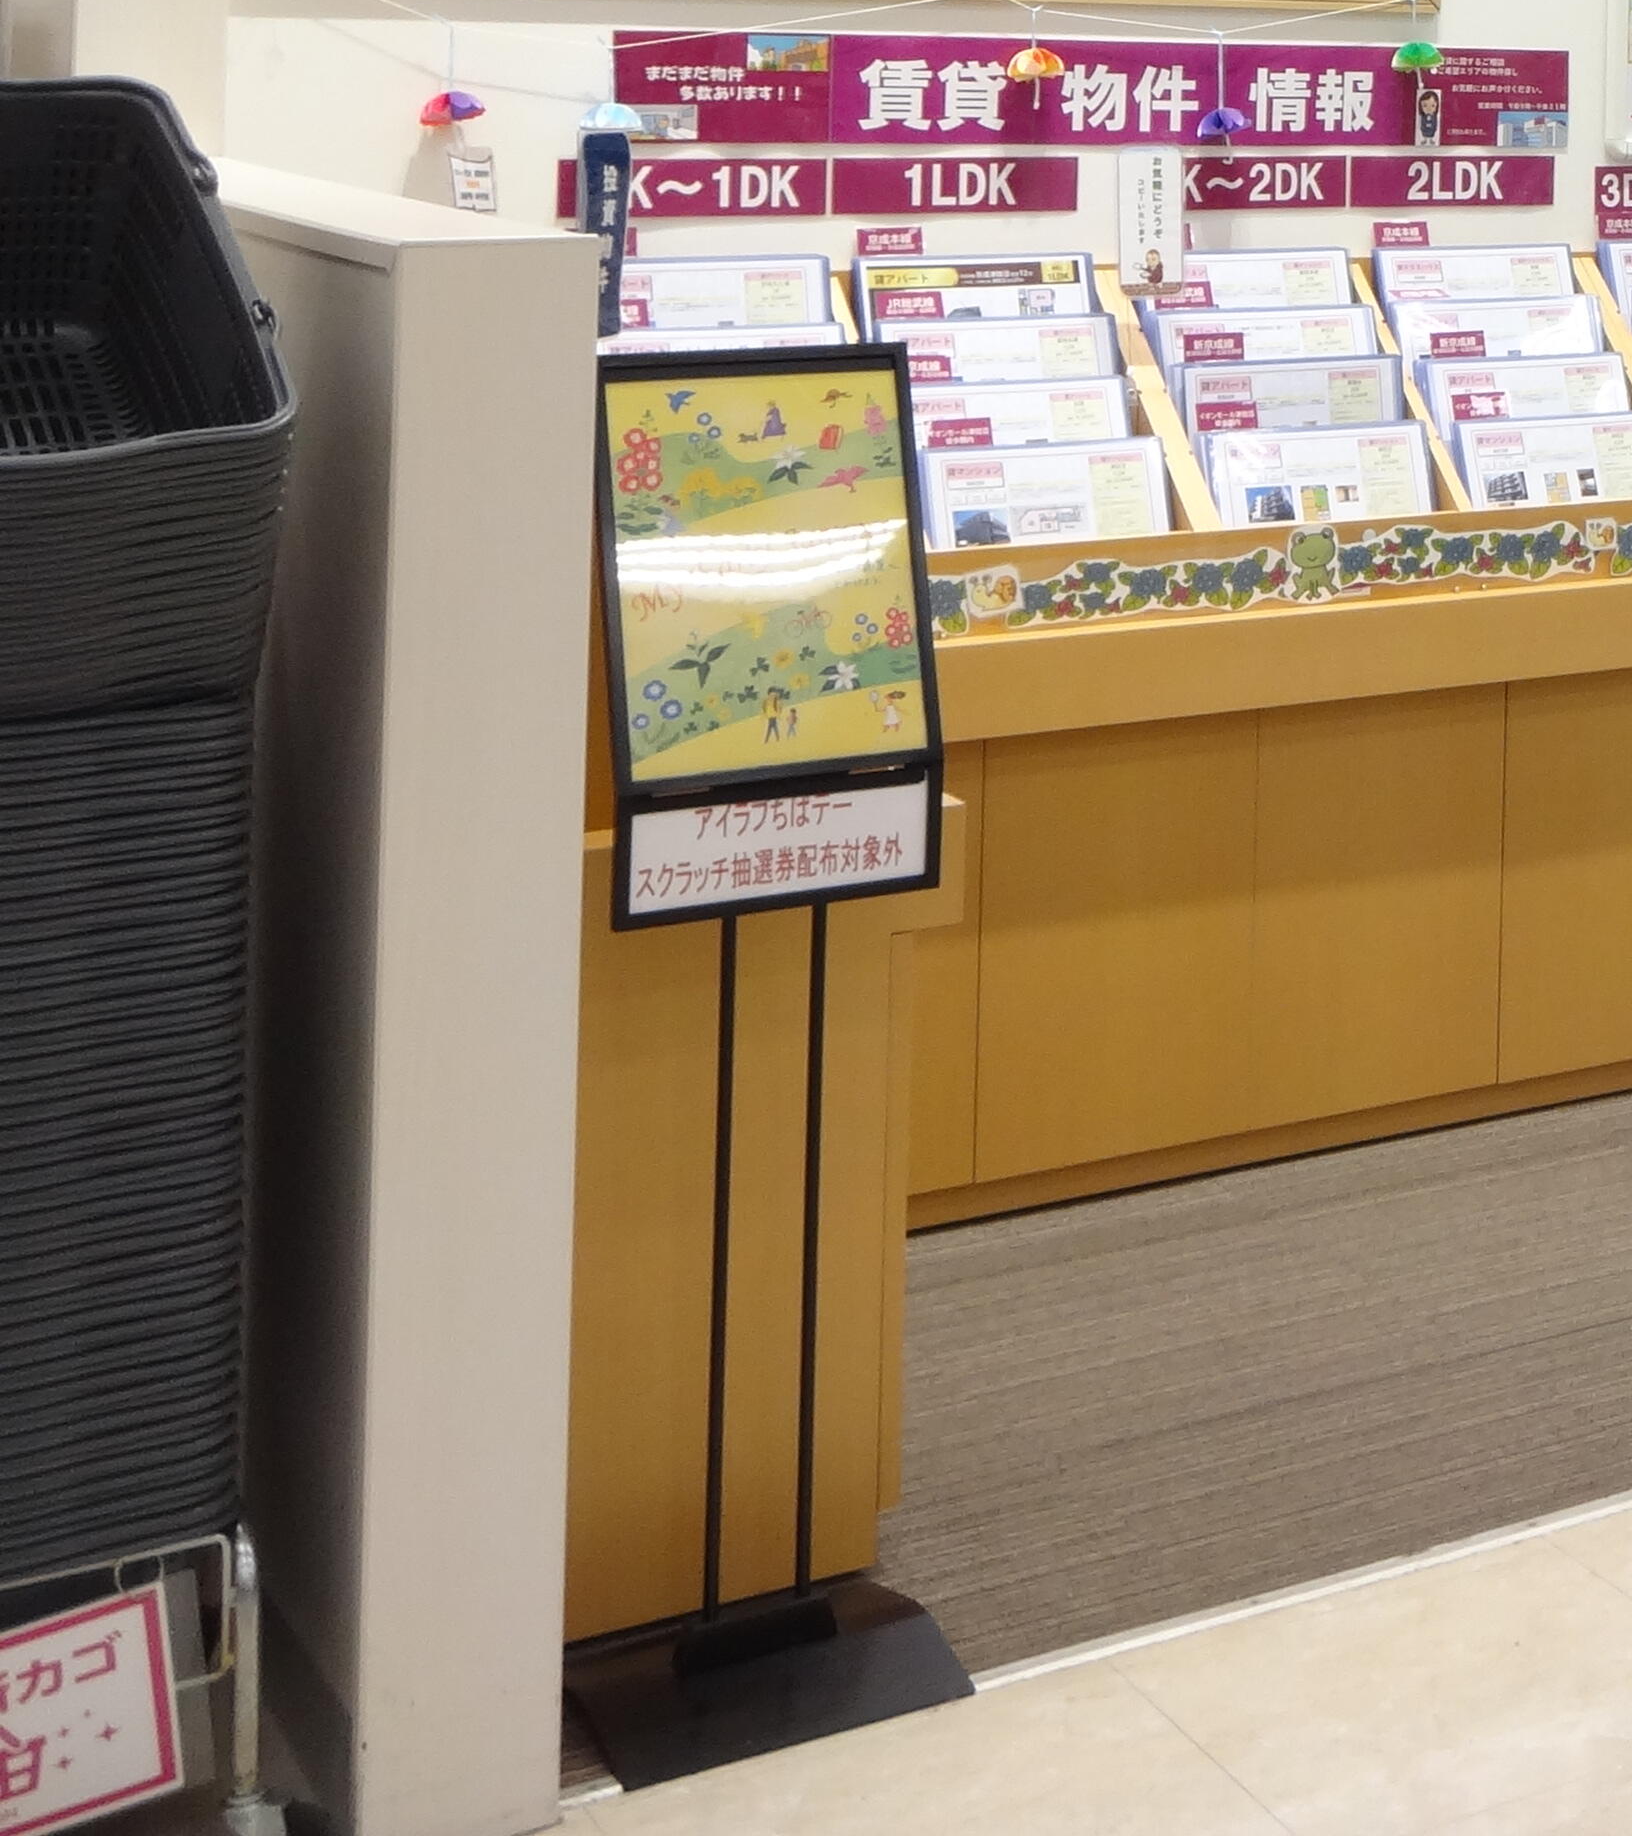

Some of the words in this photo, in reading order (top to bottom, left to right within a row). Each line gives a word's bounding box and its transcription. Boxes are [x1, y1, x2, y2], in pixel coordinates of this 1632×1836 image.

[645, 66, 744, 82] まだまだ物件
[858, 59, 1006, 131] 賃貸
[1061, 65, 1198, 132] 物件
[1249, 67, 1375, 132] 情報
[905, 163, 1016, 206] 1LDK
[1407, 161, 1503, 201] 2LDK
[636, 832, 902, 899] スクラッチ抽選券配布対象外
